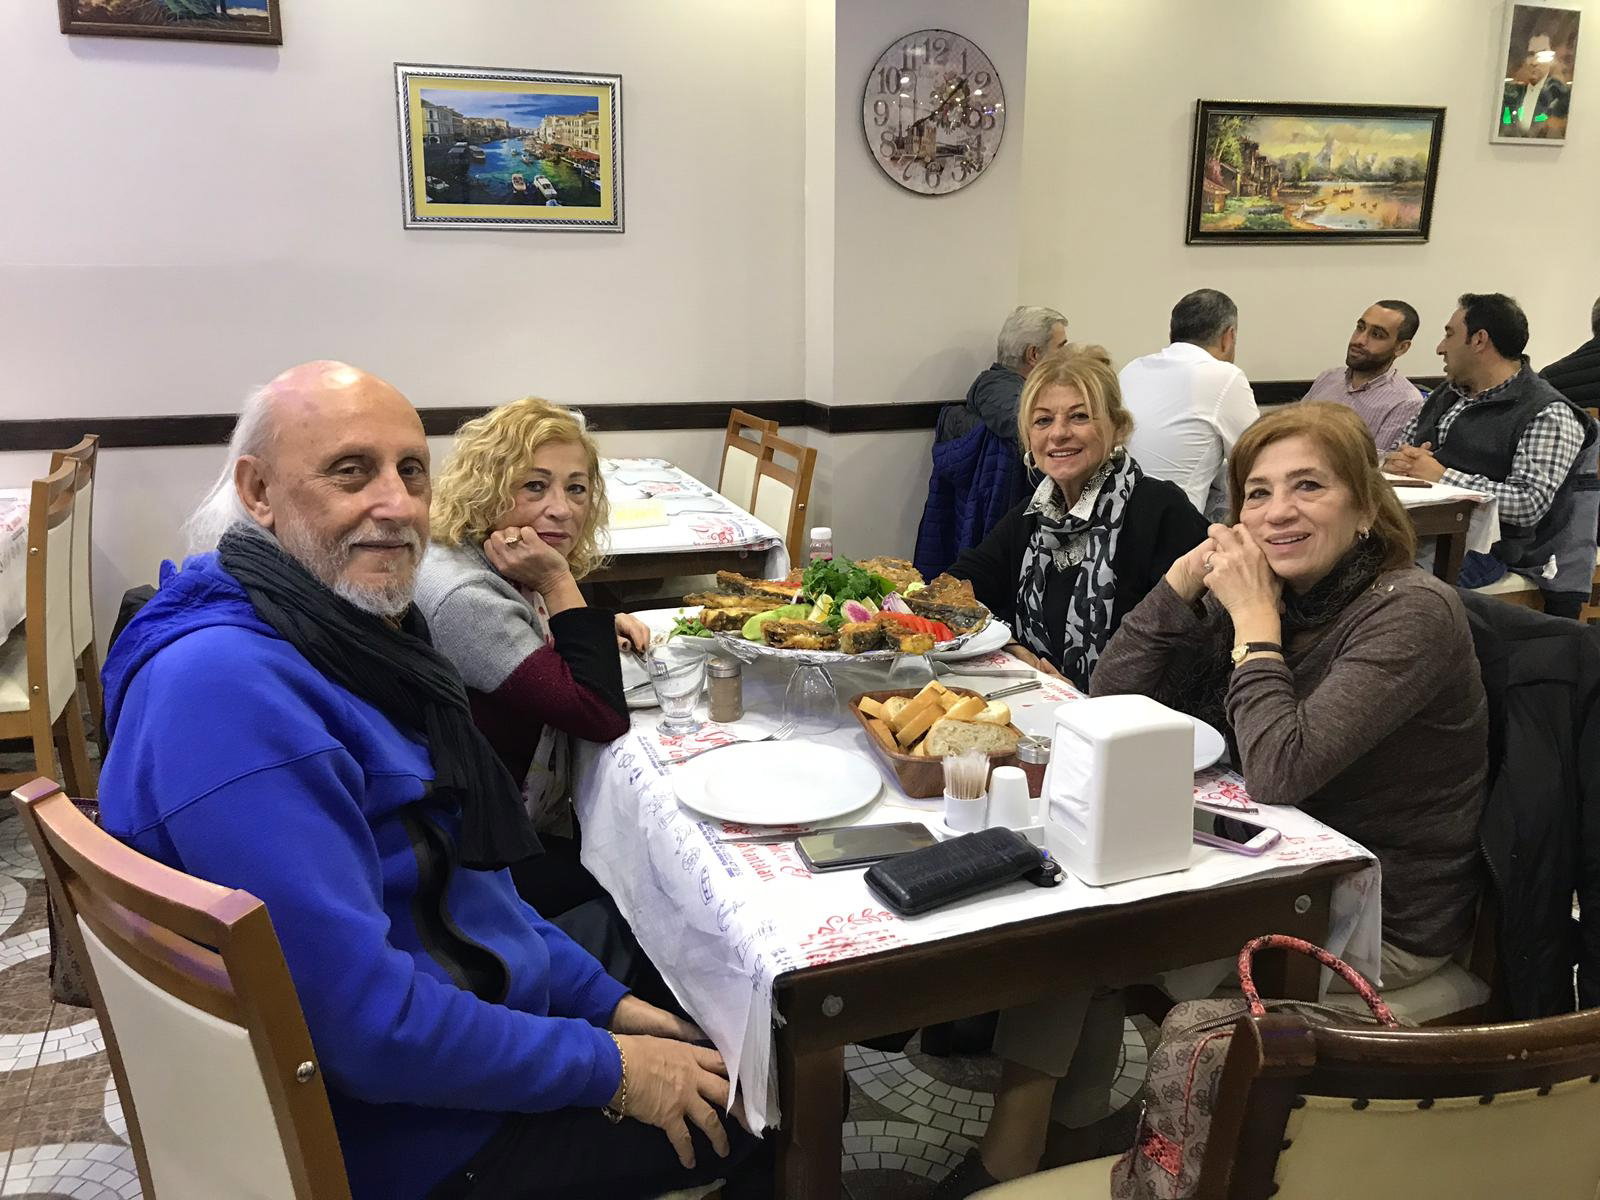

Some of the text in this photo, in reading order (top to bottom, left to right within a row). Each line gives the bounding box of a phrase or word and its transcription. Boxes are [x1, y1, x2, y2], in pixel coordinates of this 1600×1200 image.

[922, 38, 949, 65] 12
[960, 48, 970, 76] 1
[877, 67, 901, 95] 10
[974, 71, 992, 97] 2
[873, 99, 890, 127] 9
[880, 131, 896, 158] 8
[897, 154, 917, 182] 7
[924, 161, 941, 189] 6
[951, 155, 967, 182] 5
